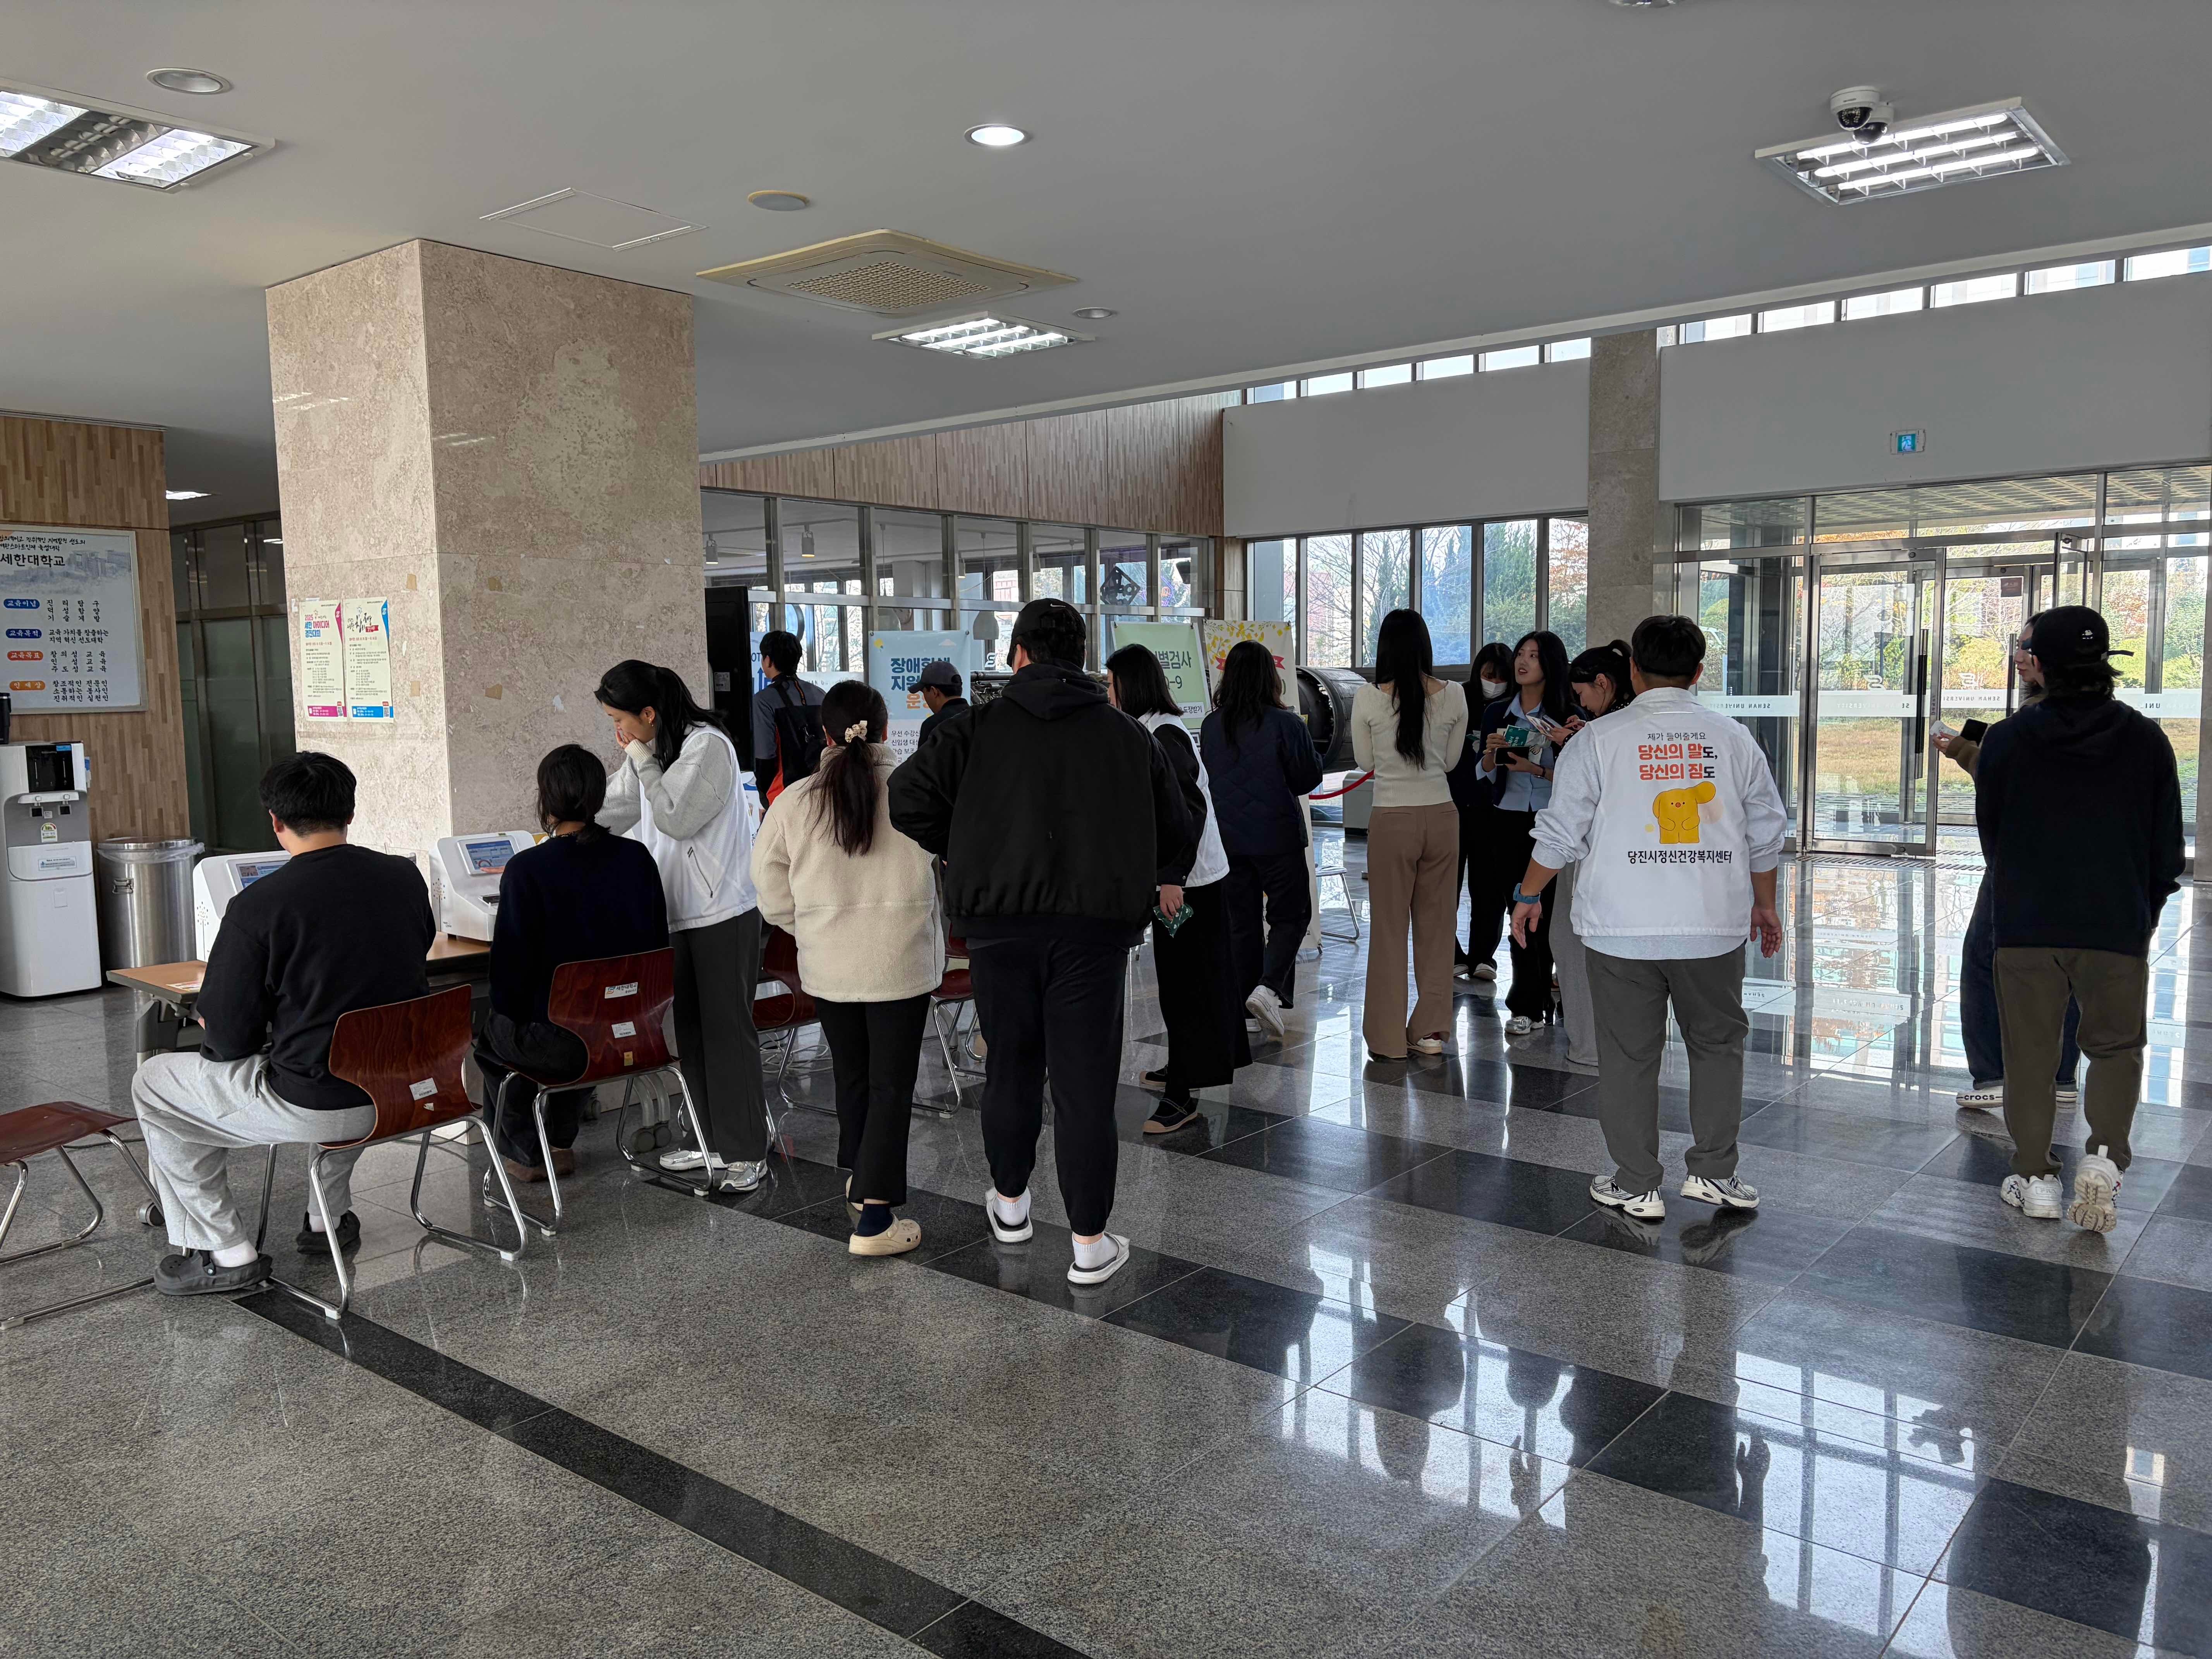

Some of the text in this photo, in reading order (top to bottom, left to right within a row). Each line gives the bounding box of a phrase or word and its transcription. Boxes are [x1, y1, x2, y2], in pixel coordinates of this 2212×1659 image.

[0, 554, 65, 567] 세한대학교
[1155, 651, 1191, 669] 별검사
[907, 694, 929, 709] 운
[1647, 732, 1706, 741] 제가 들어줄게요
[1638, 743, 1717, 760] 당신의 말도,
[1639, 763, 1715, 780] 당신의 짐도
[1628, 850, 1732, 864] 당진시정신건강복지센터
